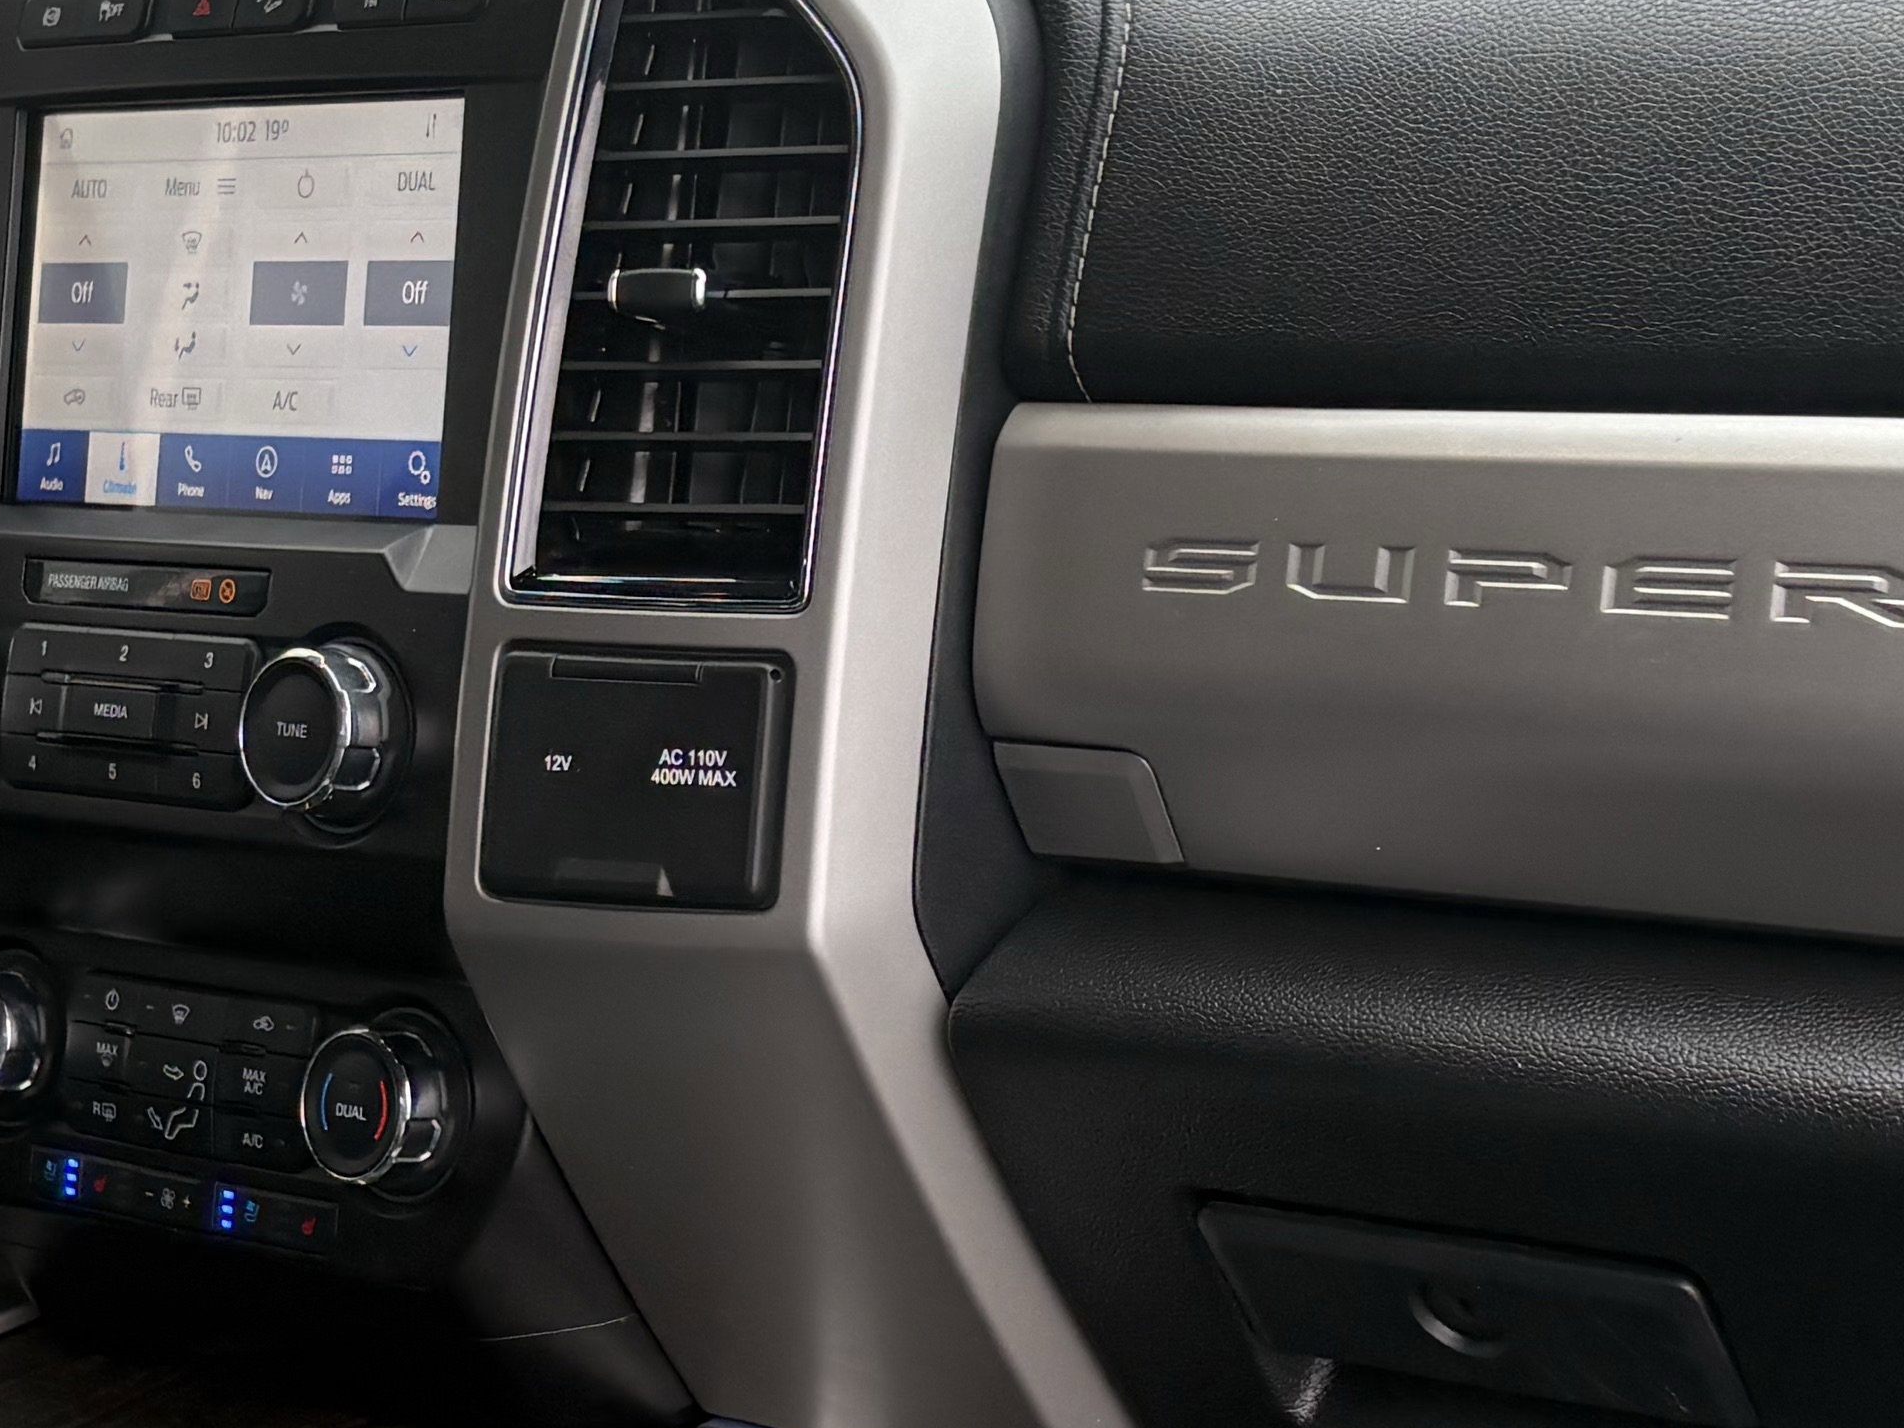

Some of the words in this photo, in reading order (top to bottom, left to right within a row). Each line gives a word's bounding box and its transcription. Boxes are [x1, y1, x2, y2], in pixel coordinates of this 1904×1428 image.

[215, 121, 257, 143] 10:02
[71, 179, 108, 199] AUTO
[165, 177, 201, 197] Menu
[397, 170, 436, 192] DUAL
[70, 280, 94, 304] Off
[401, 279, 428, 305] Off
[149, 387, 179, 409] Rear
[271, 390, 299, 413] A/C
[39, 476, 64, 492] Audio
[177, 482, 205, 498] Phone
[255, 485, 273, 501] Nav
[327, 488, 352, 505] Apps
[397, 491, 437, 511] Settings
[48, 573, 97, 589] PASSENGER
[98, 576, 129, 592] AIRBAG
[40, 640, 48, 656] 1
[119, 645, 130, 662] 2
[203, 652, 214, 669] 3
[93, 703, 128, 719] MEDIA
[276, 721, 308, 739] TUNE
[545, 755, 572, 771] 12V
[658, 749, 683, 766] AC
[688, 750, 728, 767] 110V
[27, 756, 37, 771] 4
[108, 764, 117, 780] 5
[192, 773, 202, 789] 6
[651, 769, 695, 786] 400W
[698, 770, 737, 788] MAX
[96, 1041, 118, 1057] MAX
[242, 1067, 266, 1083] MAX
[243, 1081, 264, 1096] A/C
[335, 1102, 367, 1122] DUAL
[242, 1133, 264, 1149] A/C
